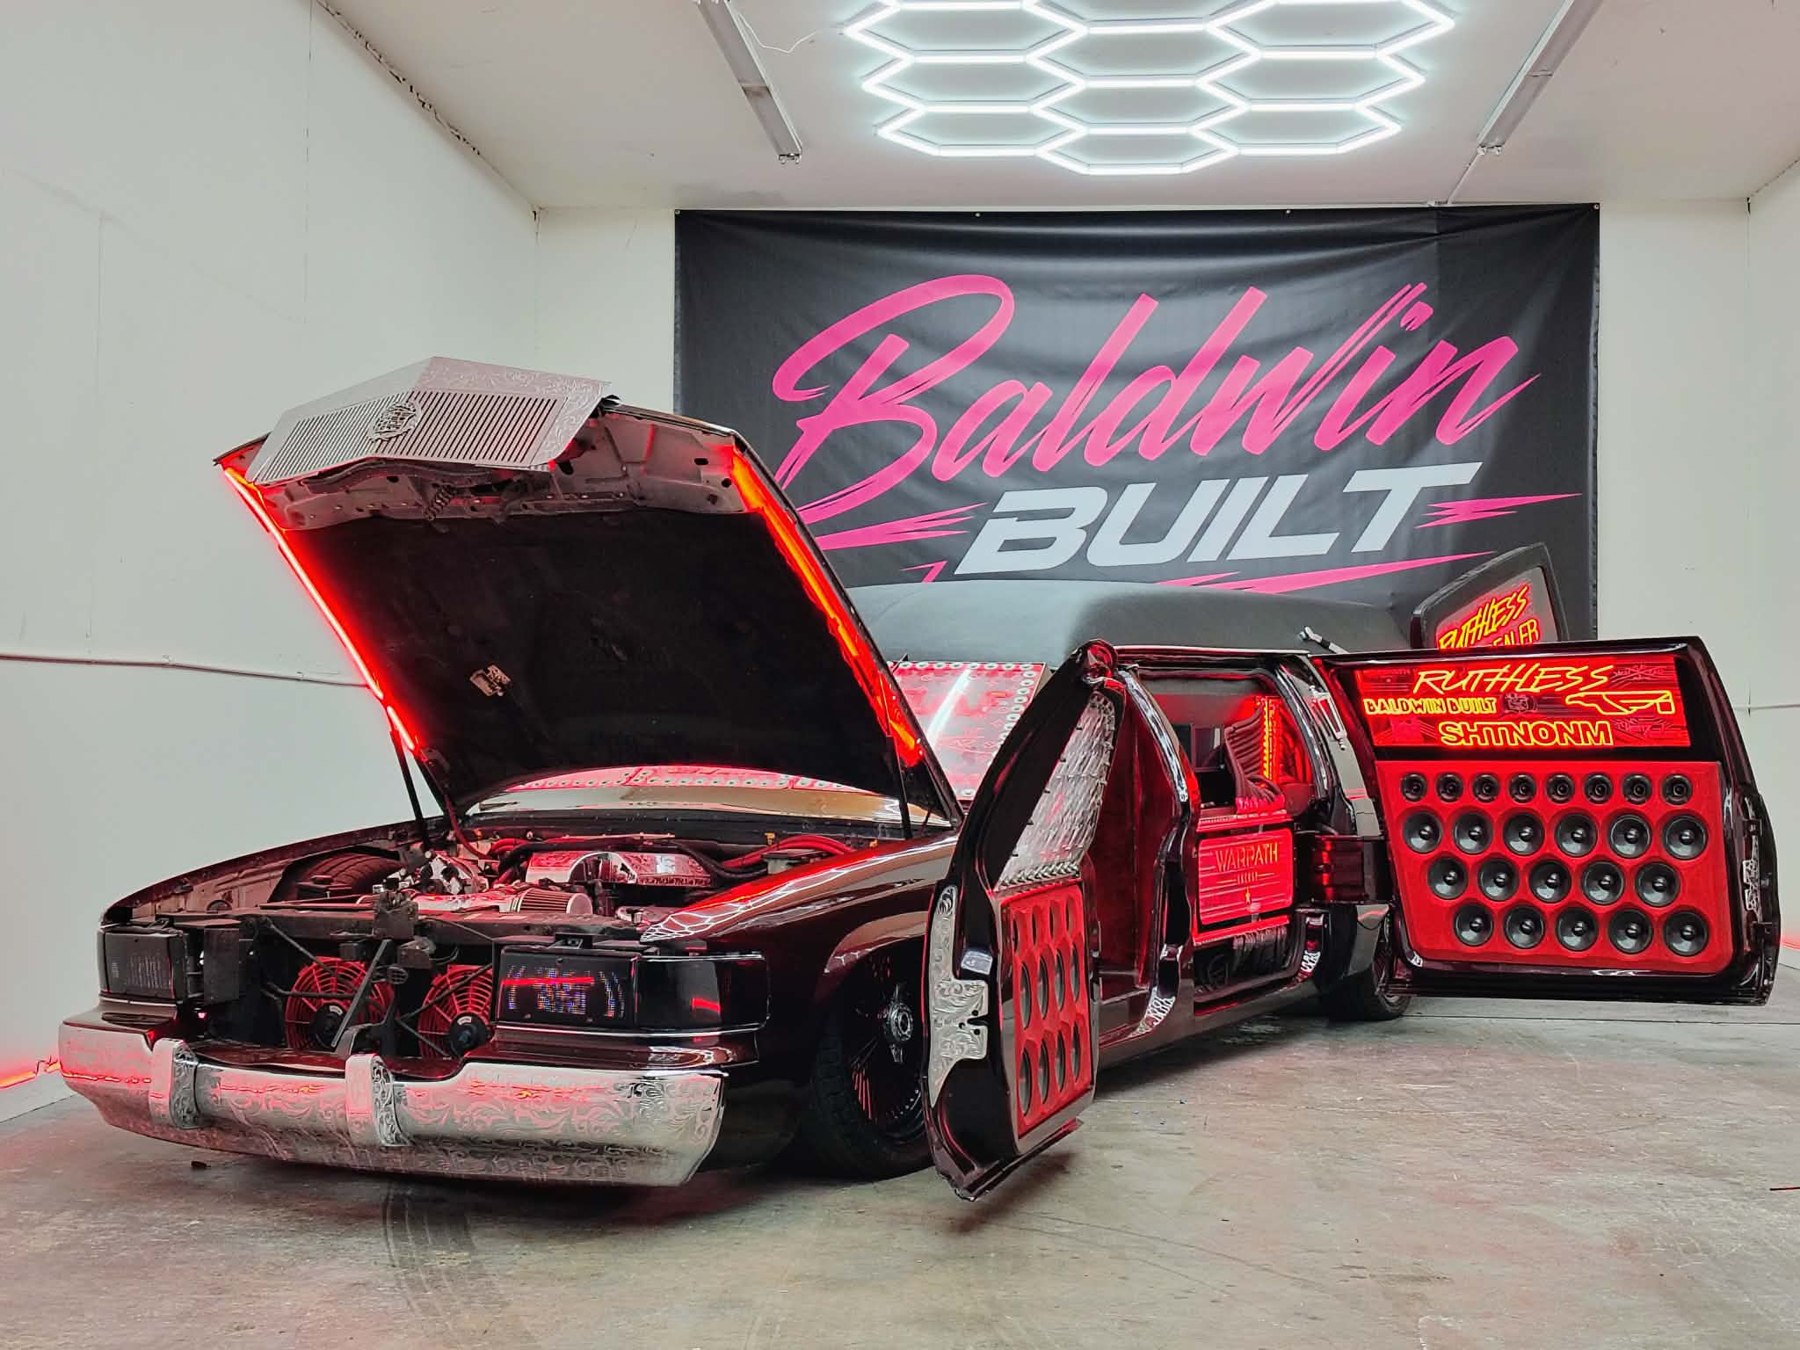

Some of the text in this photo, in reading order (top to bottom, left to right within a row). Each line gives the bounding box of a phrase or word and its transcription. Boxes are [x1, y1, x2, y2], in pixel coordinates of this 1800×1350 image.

[772, 273, 1542, 525] Baldwin
[954, 462, 1483, 575] BUILT
[1413, 663, 1614, 694] RUTHLESS
[1363, 697, 1497, 715] BALDWIN BUILT
[1214, 842, 1279, 873] WARPATH
